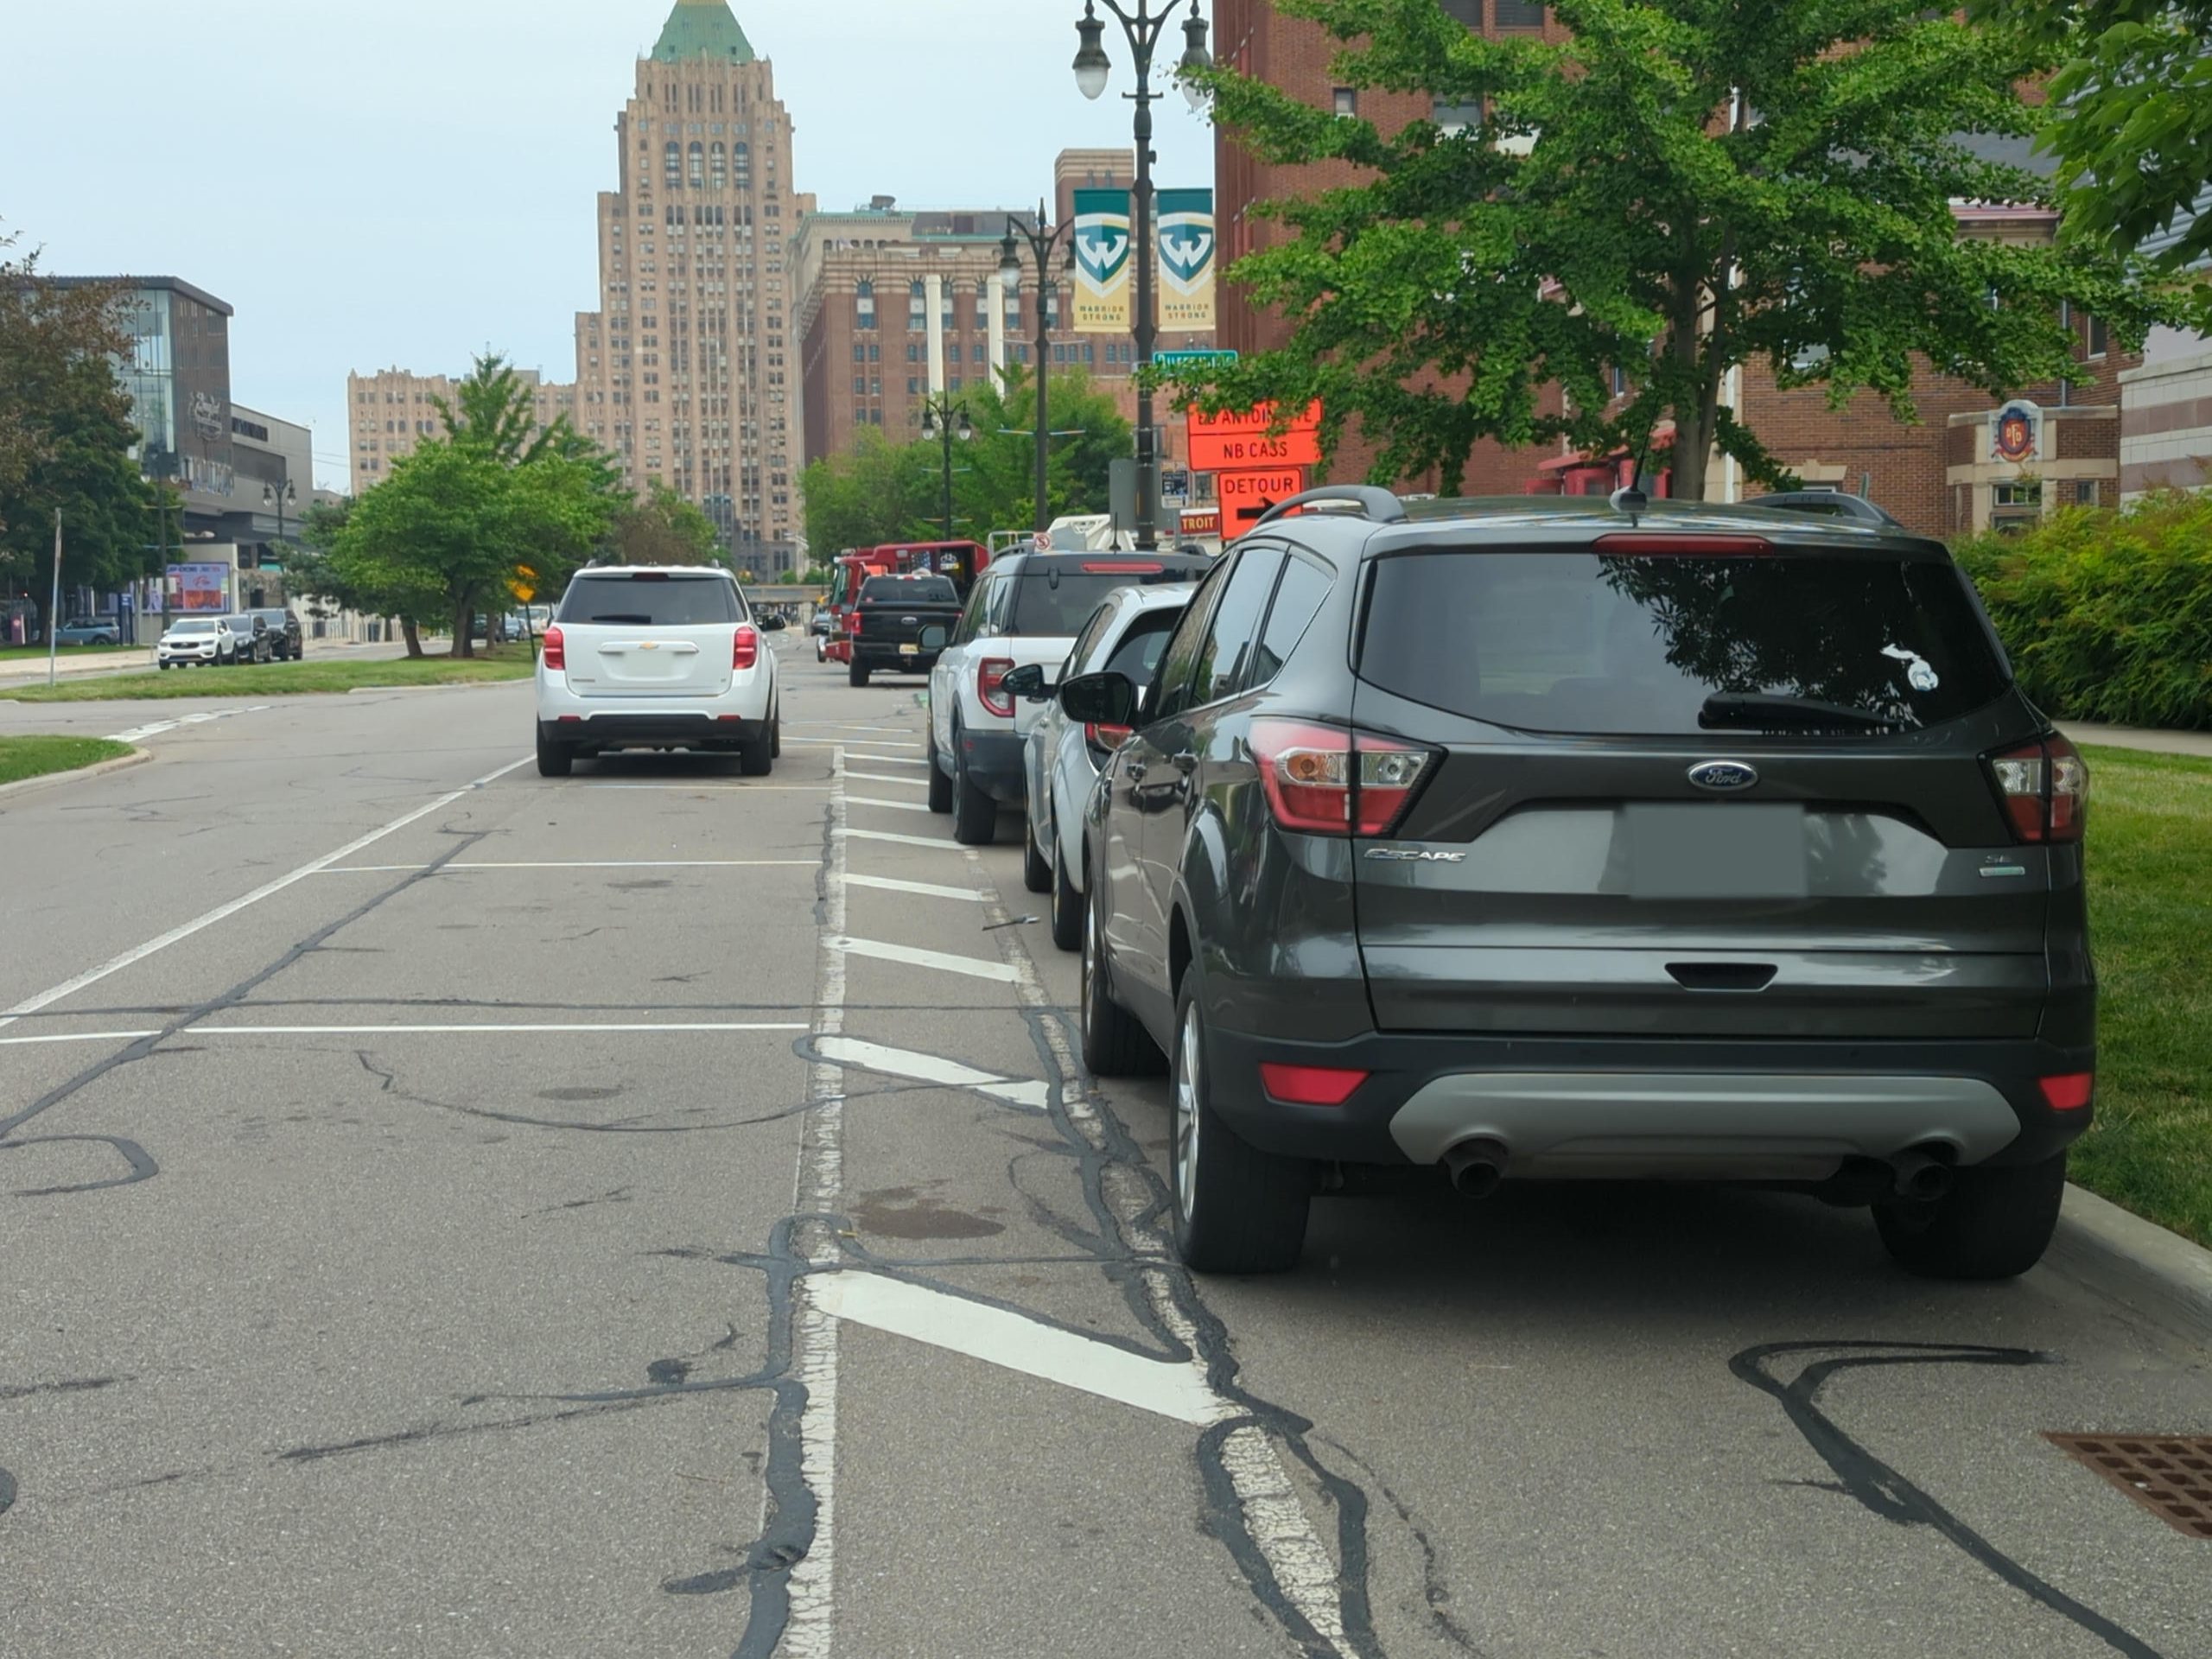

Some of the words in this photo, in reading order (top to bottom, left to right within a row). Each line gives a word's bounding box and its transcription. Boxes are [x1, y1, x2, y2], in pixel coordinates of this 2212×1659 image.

[1083, 313, 1122, 321] STRONG
[1167, 311, 1207, 320] STRONG
[1224, 443, 1244, 459] NB
[1249, 442, 1288, 458] CASS
[1224, 477, 1294, 494] DETOUR
[1705, 767, 1744, 785] Ford
[1363, 848, 1467, 862] ESCAPE
